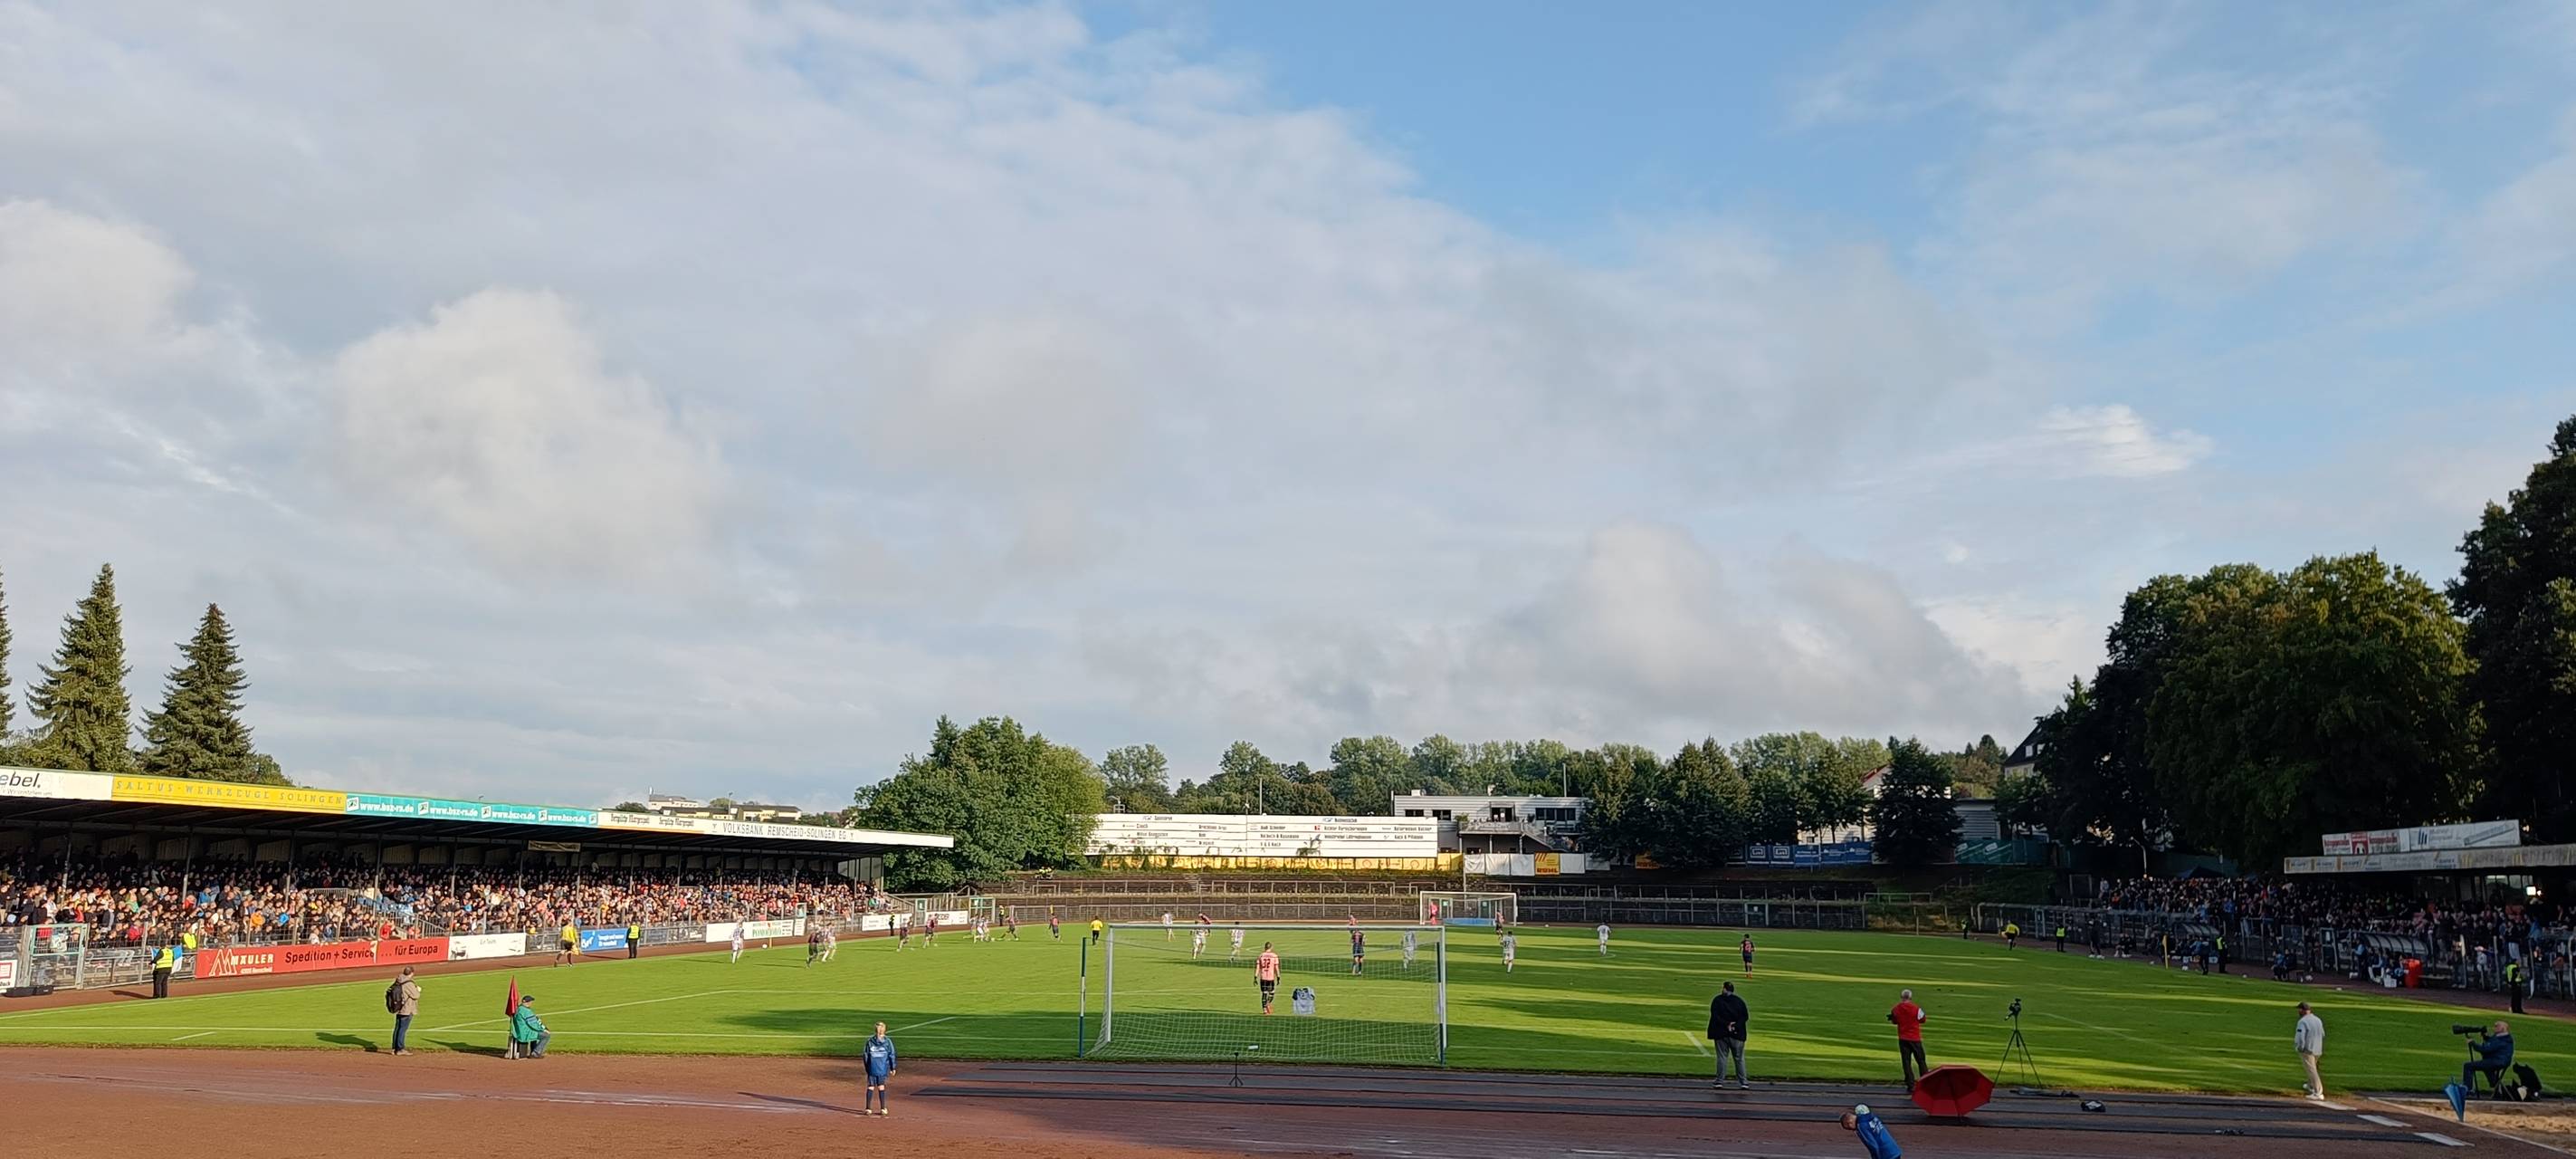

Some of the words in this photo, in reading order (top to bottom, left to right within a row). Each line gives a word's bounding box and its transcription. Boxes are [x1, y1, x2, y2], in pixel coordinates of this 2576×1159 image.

[280, 791, 343, 804] SOLINGEN
[359, 801, 415, 814] www.bsz-rs.de
[430, 806, 478, 817] www.bsz-rs.de
[491, 809, 536, 820] www.bsz-rs.de
[722, 822, 764, 835] VOLKSBANK
[285, 950, 331, 964] Spedition
[395, 945, 407, 956] für
[408, 944, 438, 955] Europa
